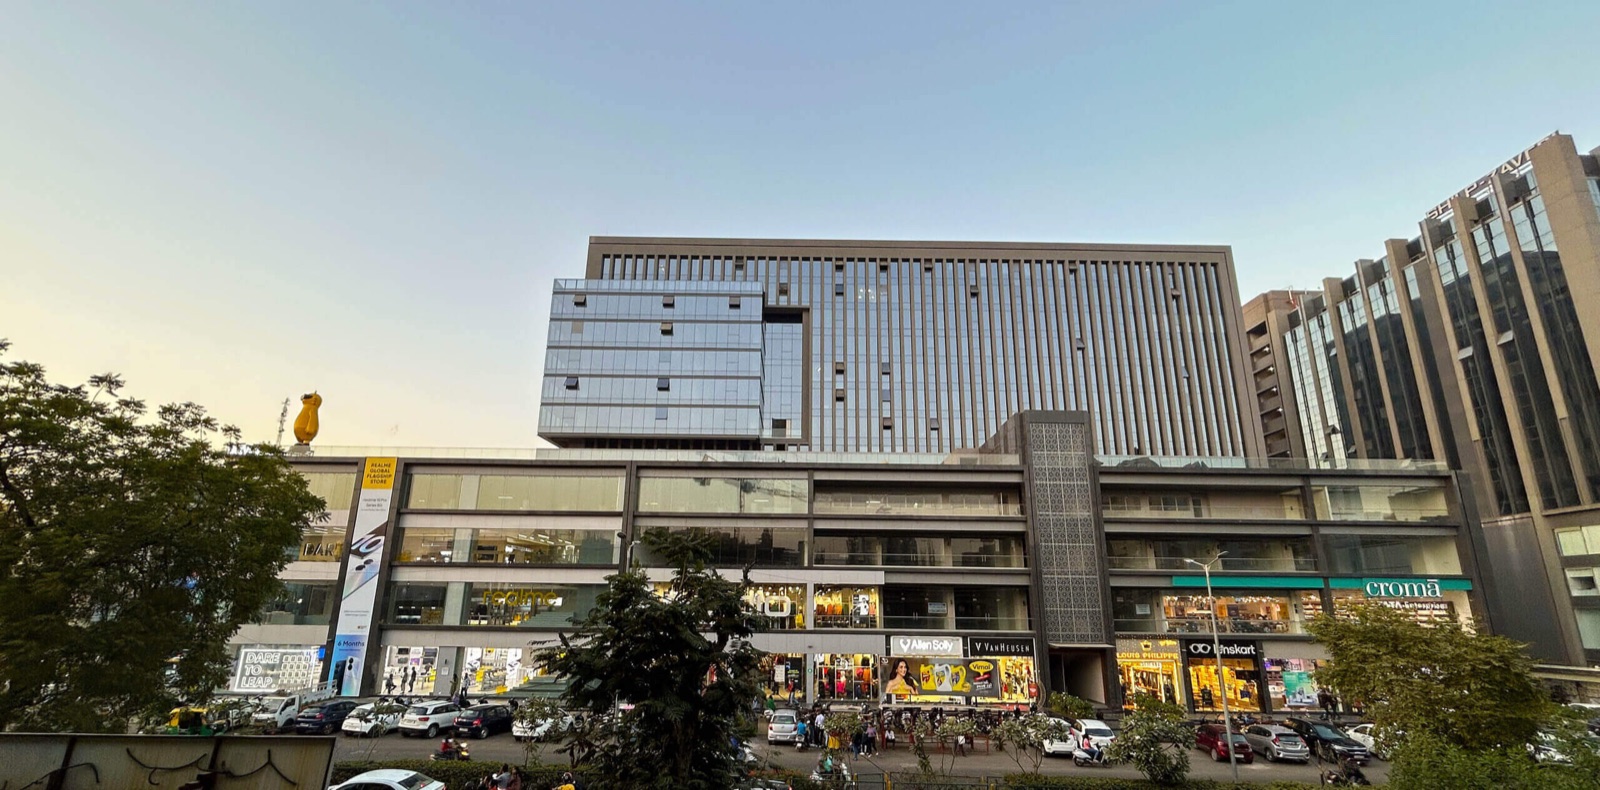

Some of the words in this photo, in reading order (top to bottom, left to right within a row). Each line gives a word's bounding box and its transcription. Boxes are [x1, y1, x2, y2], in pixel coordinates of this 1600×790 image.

[482, 588, 558, 606] realme
[910, 639, 934, 650] Allen
[934, 639, 954, 652] Solly
[245, 652, 281, 664] DARE
[244, 664, 262, 676] TO
[240, 676, 276, 688] LEAP.
